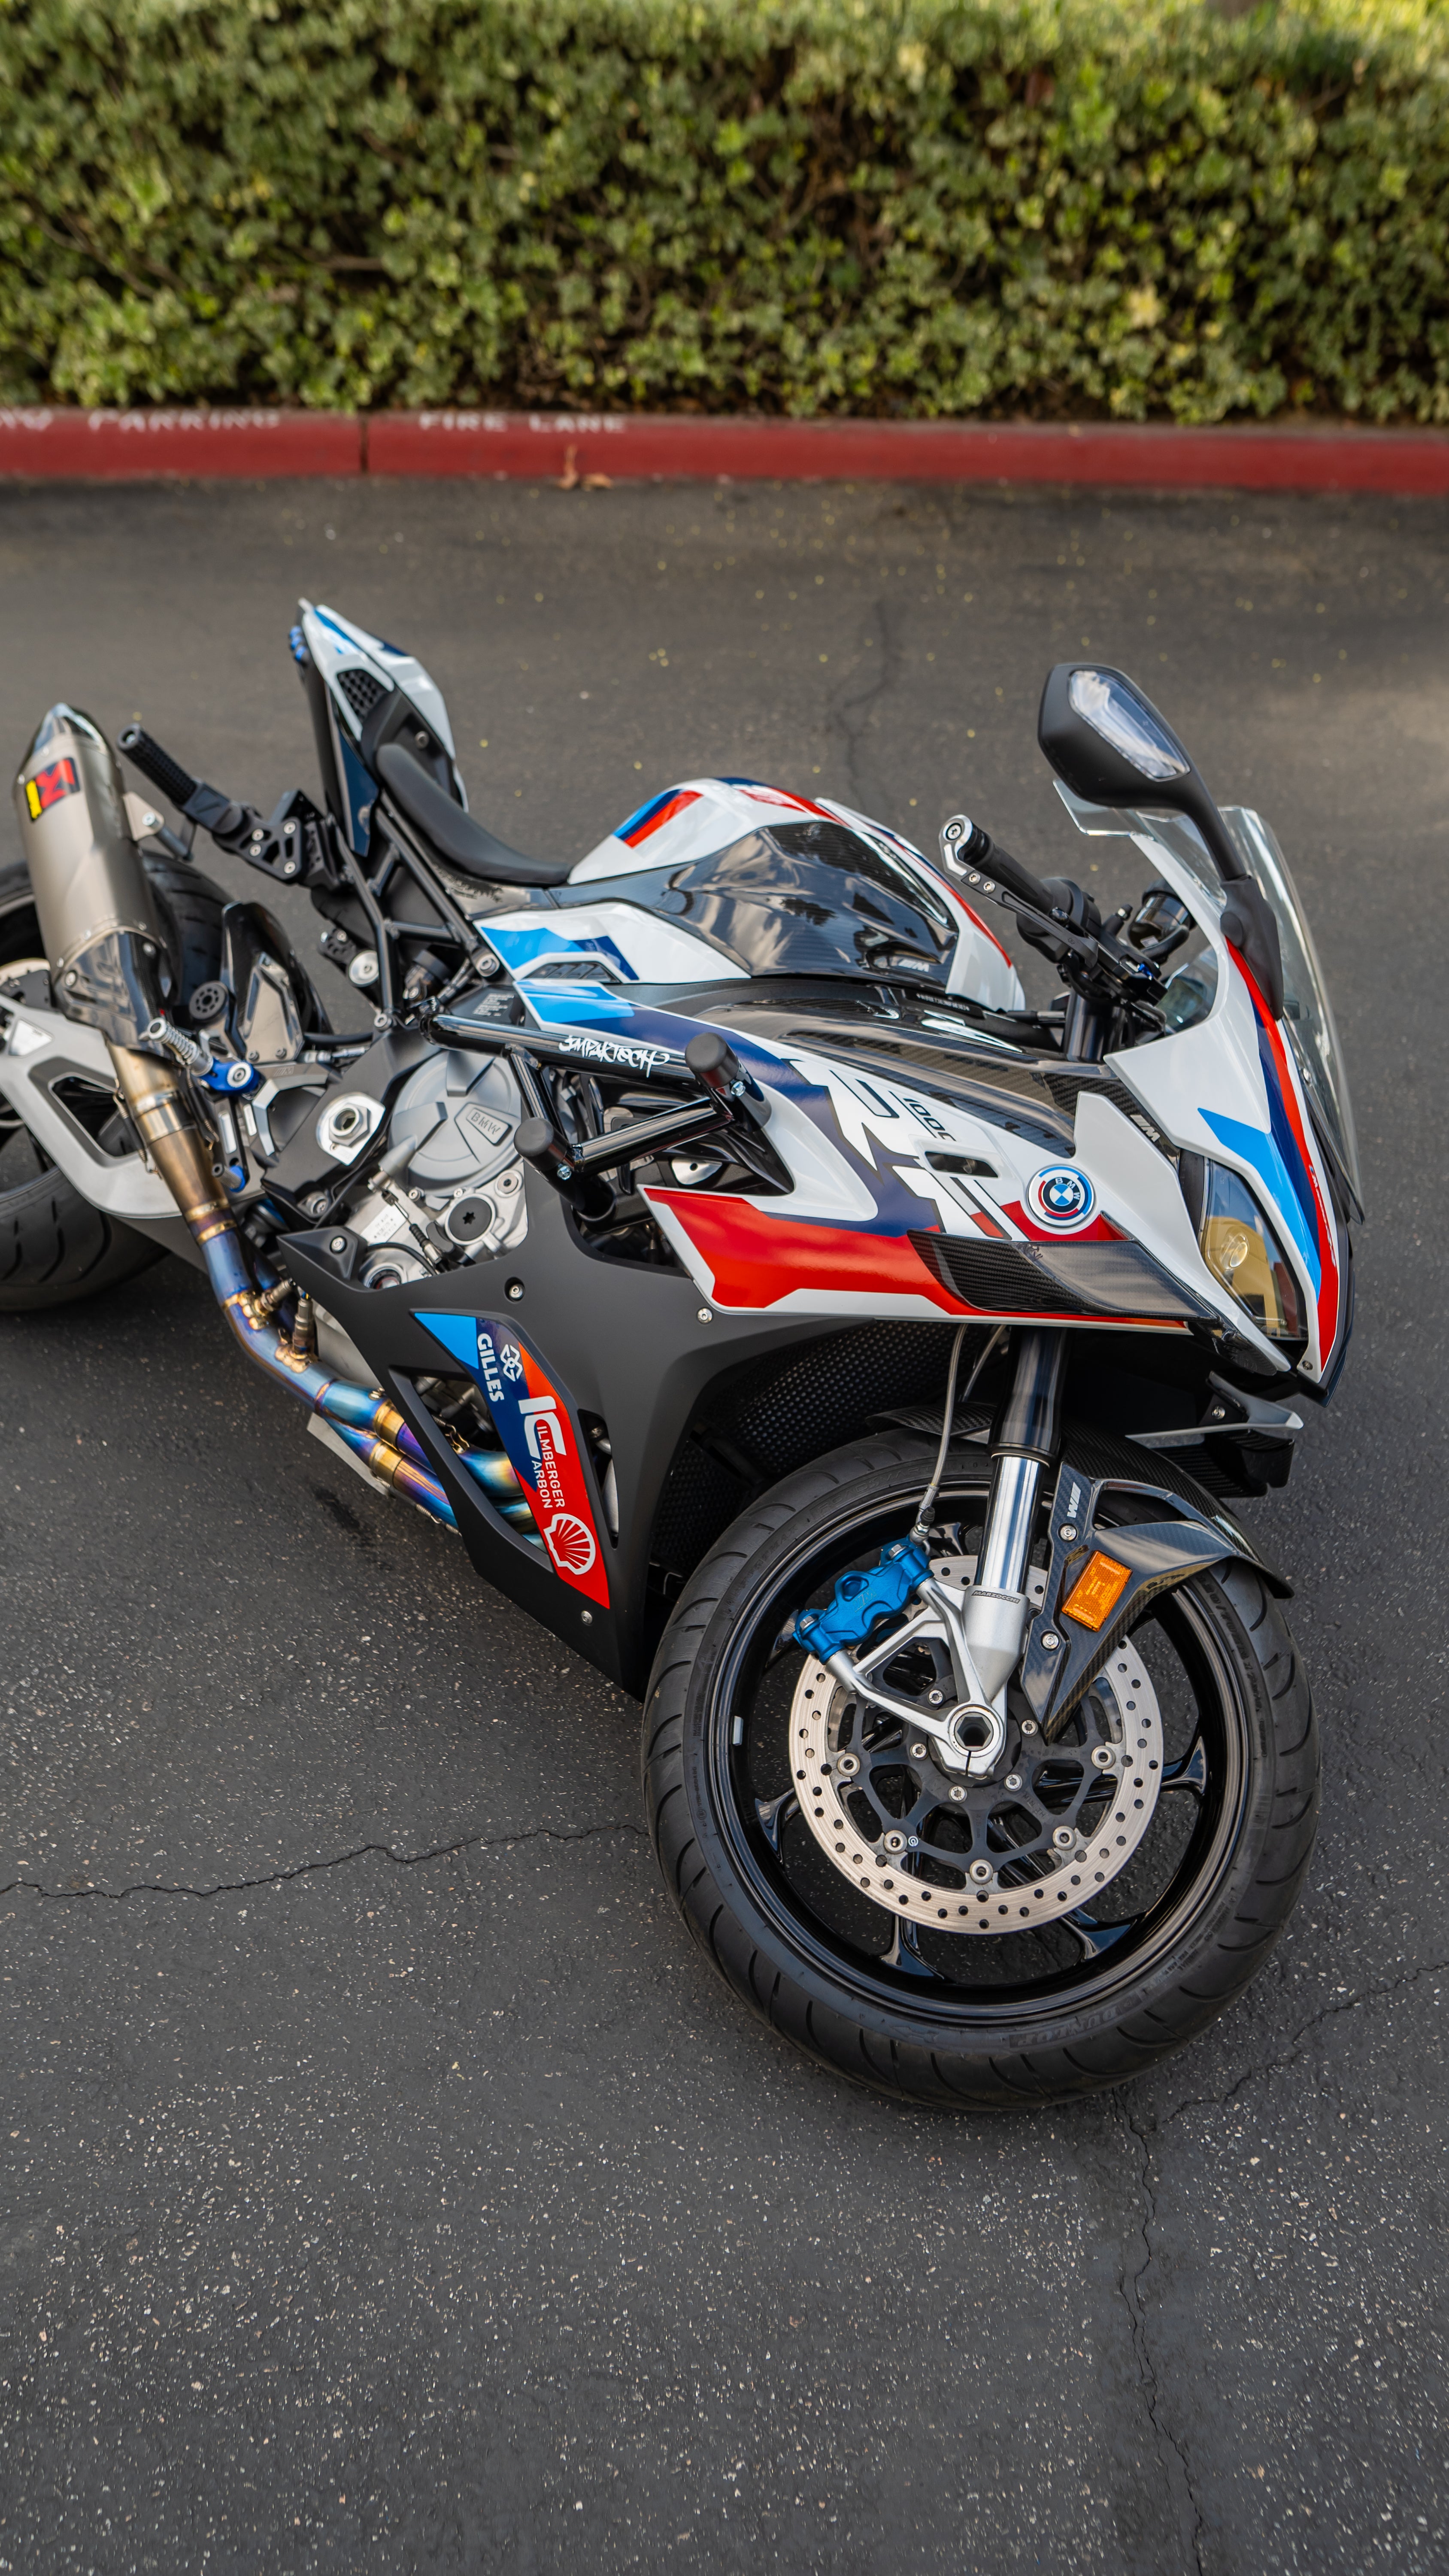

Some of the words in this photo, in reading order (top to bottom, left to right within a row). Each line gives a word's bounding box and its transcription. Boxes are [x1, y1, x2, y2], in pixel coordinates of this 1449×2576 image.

[418, 411, 507, 433] FIRE
[529, 413, 626, 434] LANE
[471, 1112, 501, 1134] BMW
[1055, 1178, 1081, 1200] BMW
[477, 1332, 505, 1403] GILLES
[972, 1590, 1021, 1604] MARZOCCHI
[1016, 2004, 1121, 2048] DUNLOP
